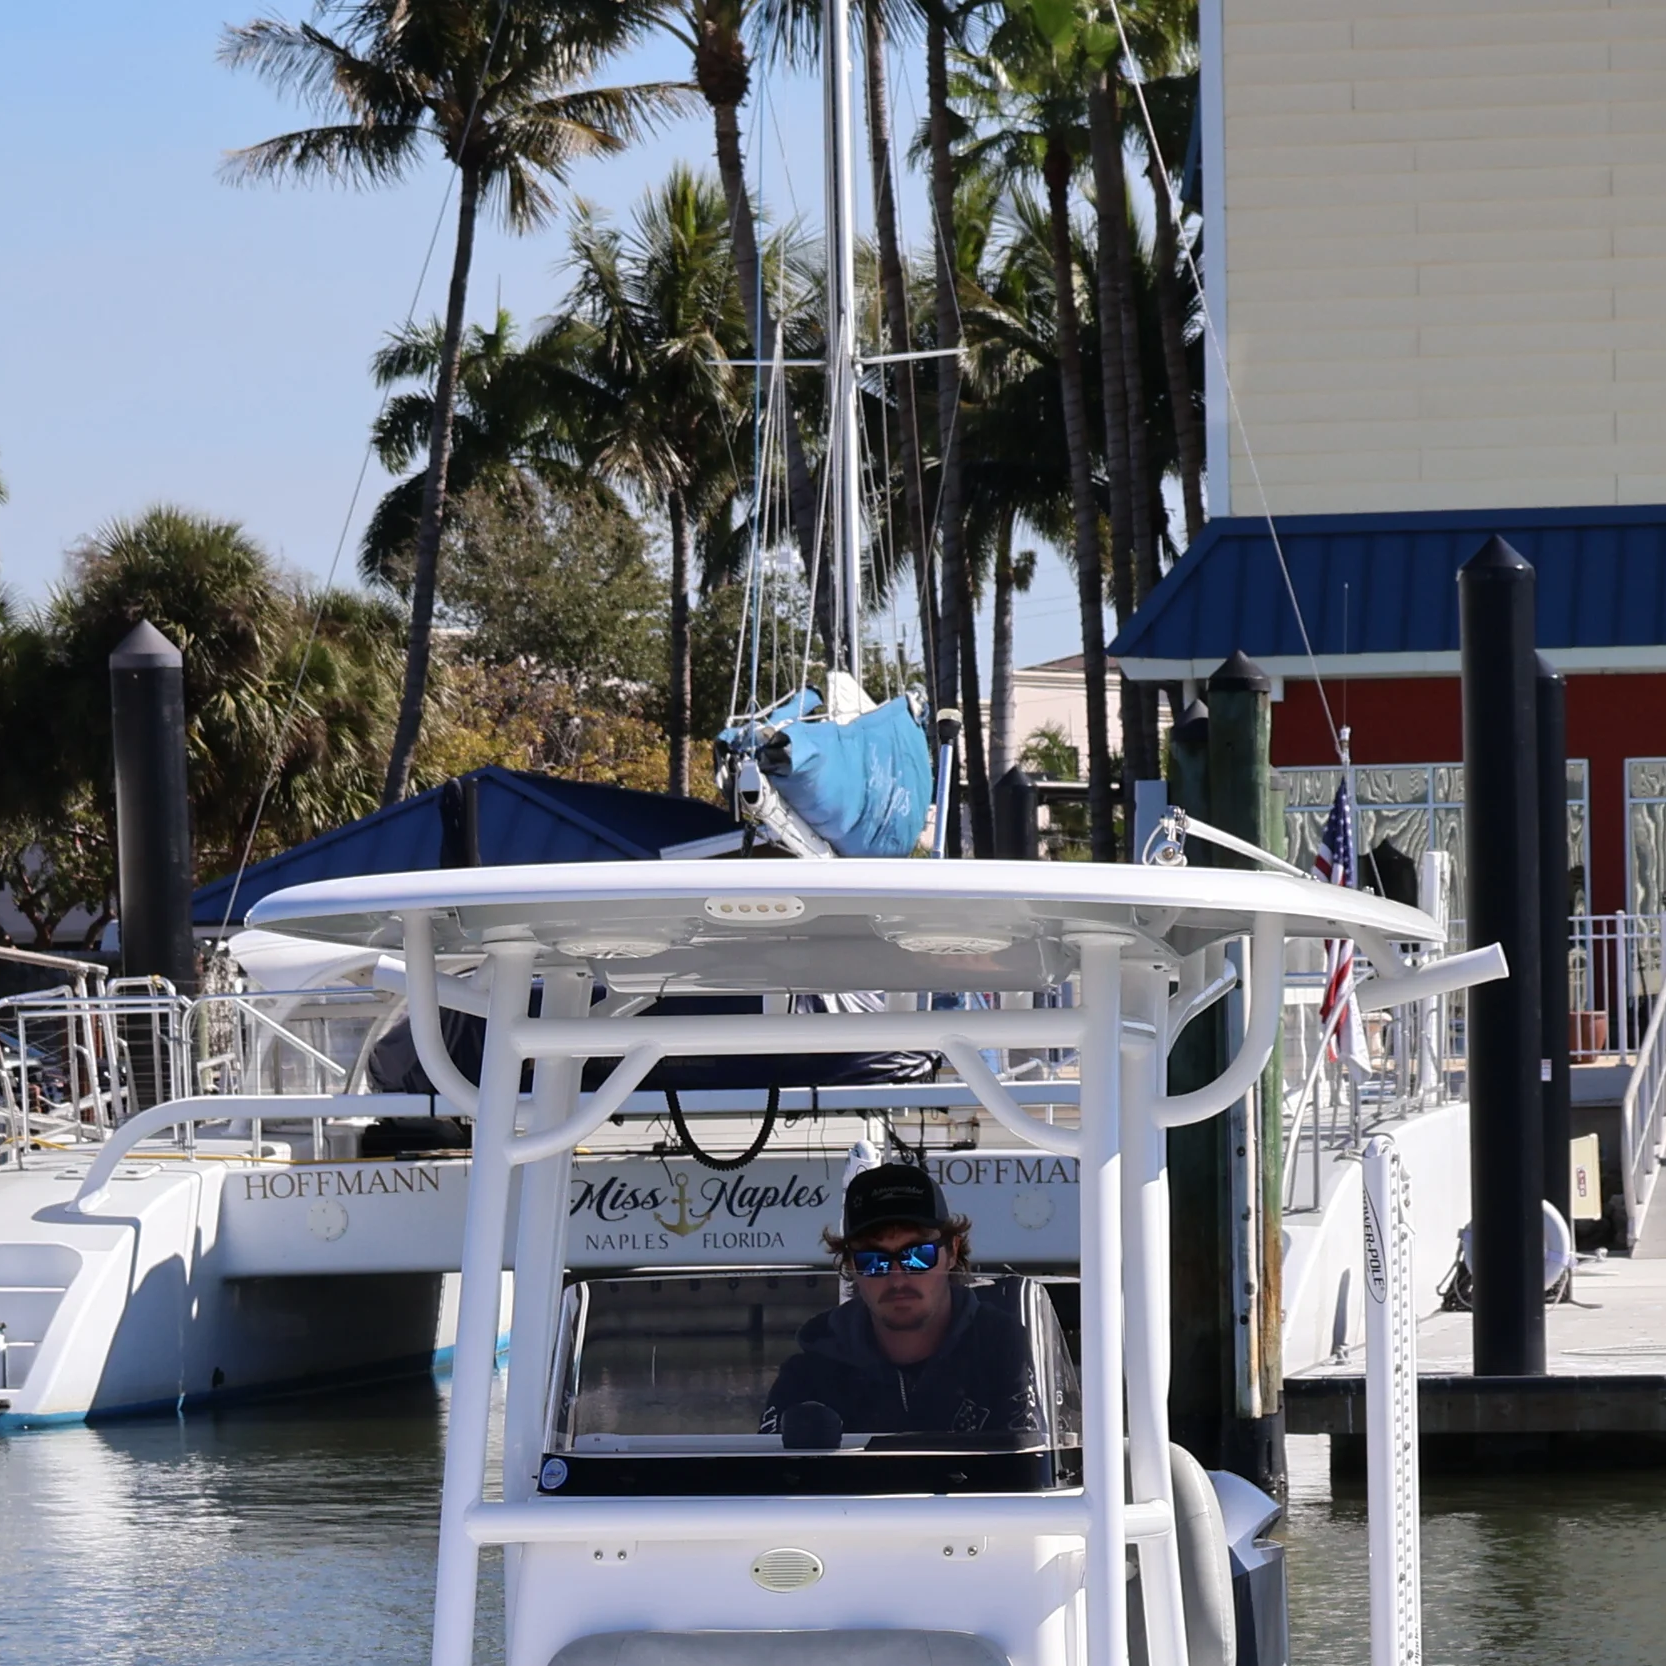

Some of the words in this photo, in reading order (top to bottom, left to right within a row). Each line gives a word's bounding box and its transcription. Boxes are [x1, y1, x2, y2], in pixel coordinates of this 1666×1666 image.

[243, 1166, 442, 1200] HOFFMANN
[570, 1176, 668, 1222] Miss
[689, 1174, 831, 1227] Naples
[585, 1232, 669, 1250] NAPLES
[703, 1231, 786, 1249] FLORIDA
[1363, 1190, 1386, 1287] WER-POLE
